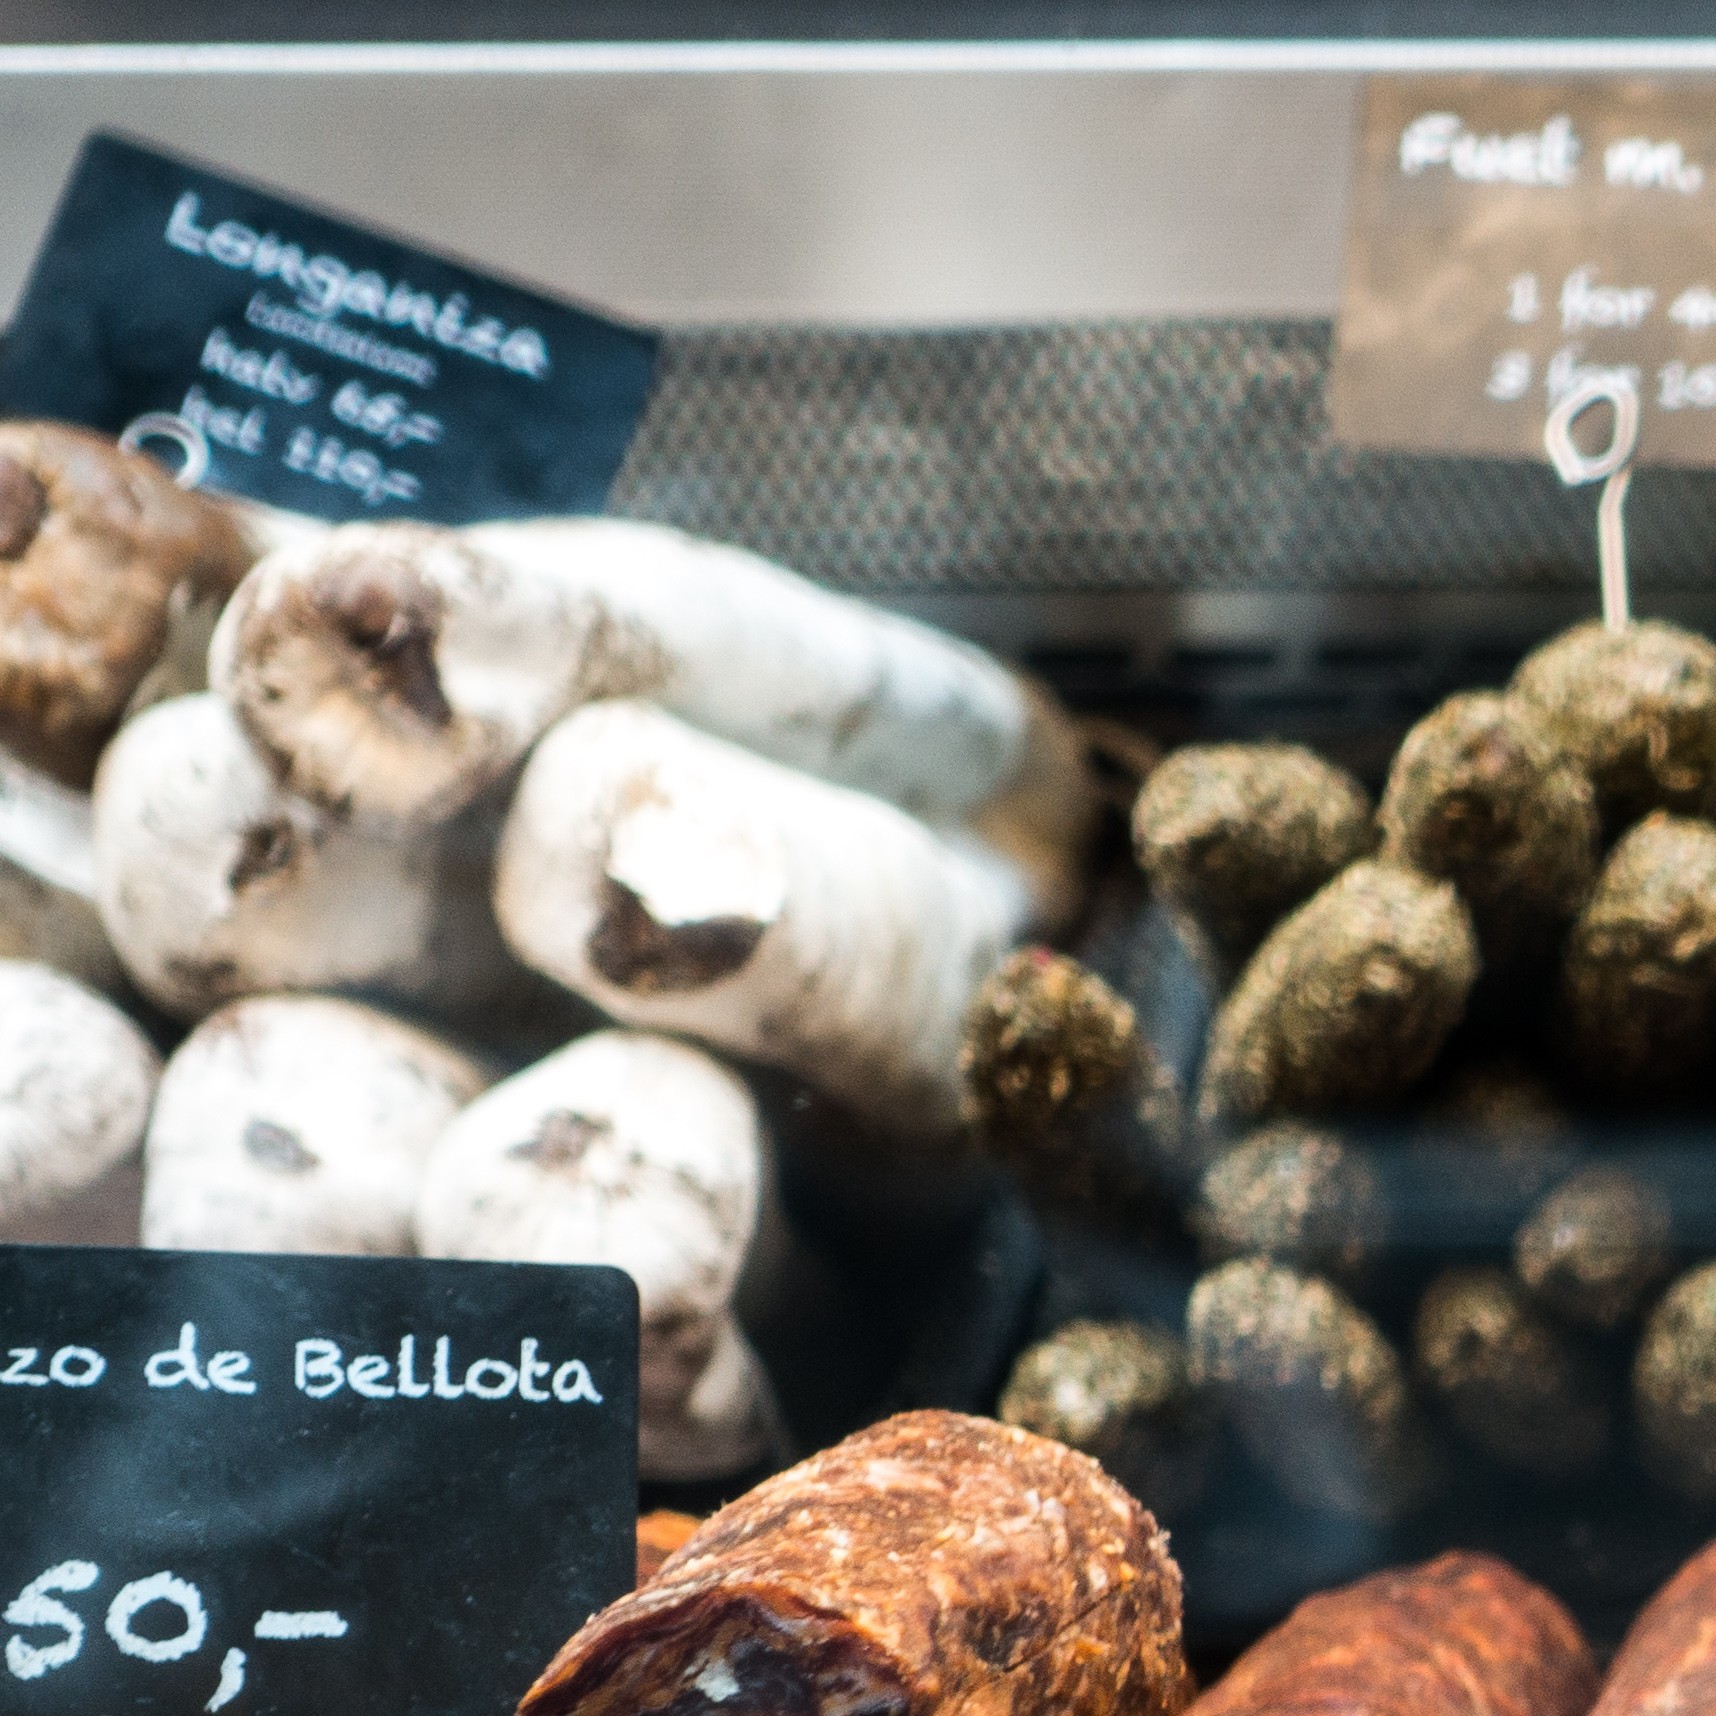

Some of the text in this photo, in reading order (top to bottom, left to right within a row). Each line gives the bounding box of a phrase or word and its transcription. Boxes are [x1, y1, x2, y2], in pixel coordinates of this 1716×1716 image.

[1400, 112, 1579, 187] Fuet
[1604, 138, 1702, 193] m.
[164, 190, 550, 379] Longaniza
[1507, 272, 1540, 324] 1
[1560, 265, 1655, 333] for
[144, 1322, 256, 1394] de
[295, 1335, 602, 1402] Bellota
